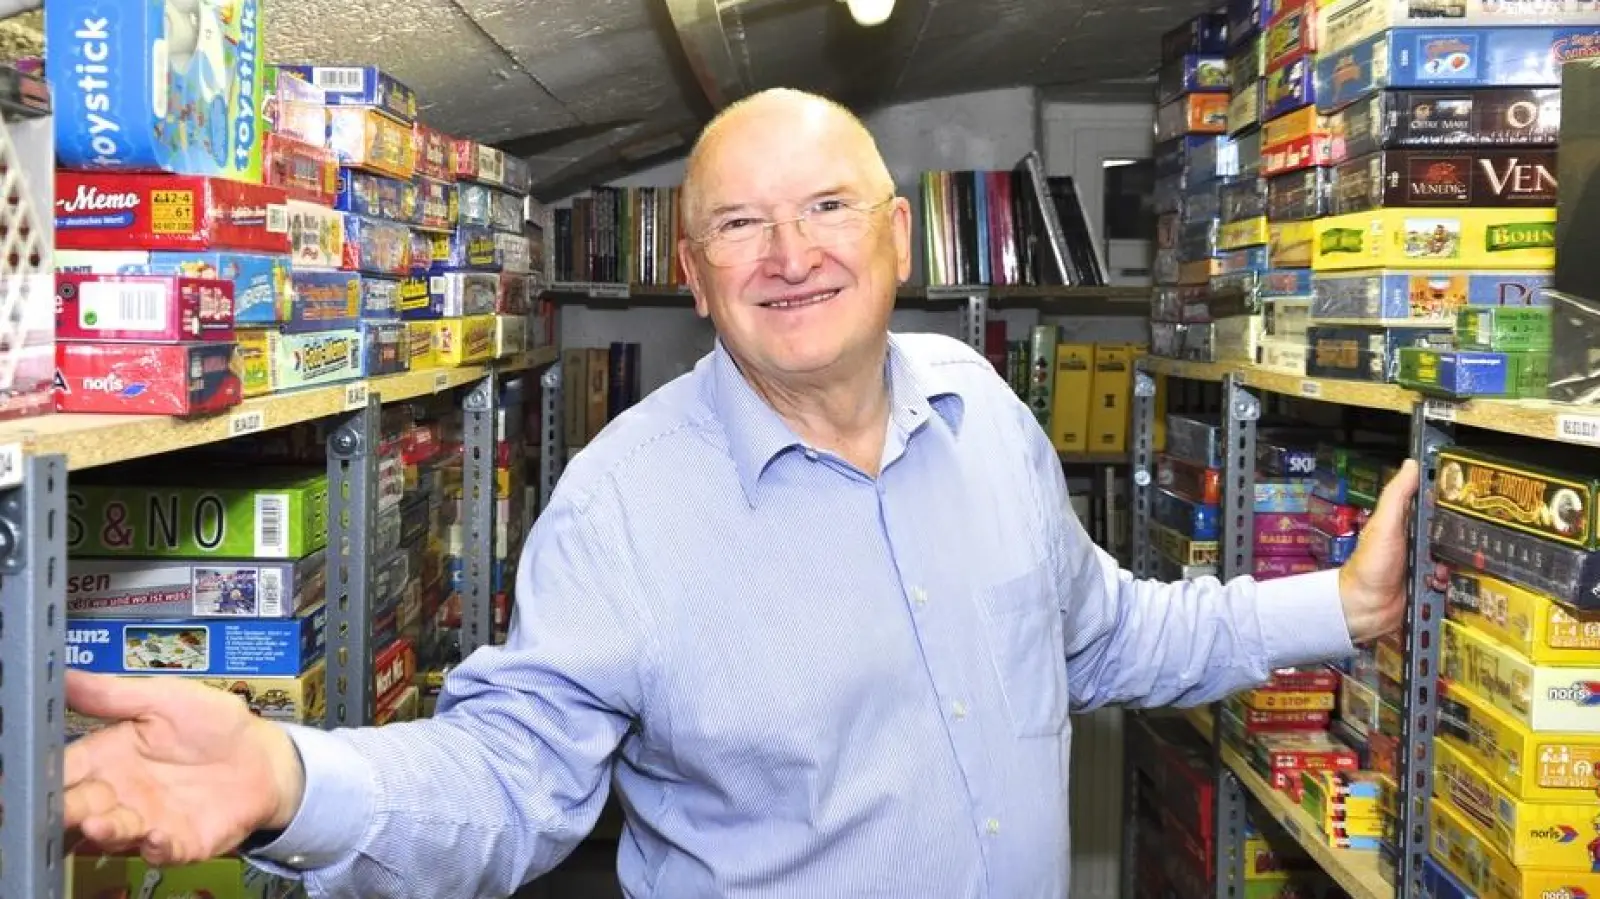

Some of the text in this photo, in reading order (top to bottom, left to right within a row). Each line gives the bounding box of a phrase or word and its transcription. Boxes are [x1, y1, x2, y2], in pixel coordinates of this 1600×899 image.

[75, 17, 121, 166] toystick
[1411, 181, 1467, 195] VENEDIG
[82, 371, 125, 393] noris
[103, 502, 132, 546] &
[148, 494, 226, 550] NO
[1549, 681, 1587, 701] noris
[1530, 826, 1562, 840] noris
